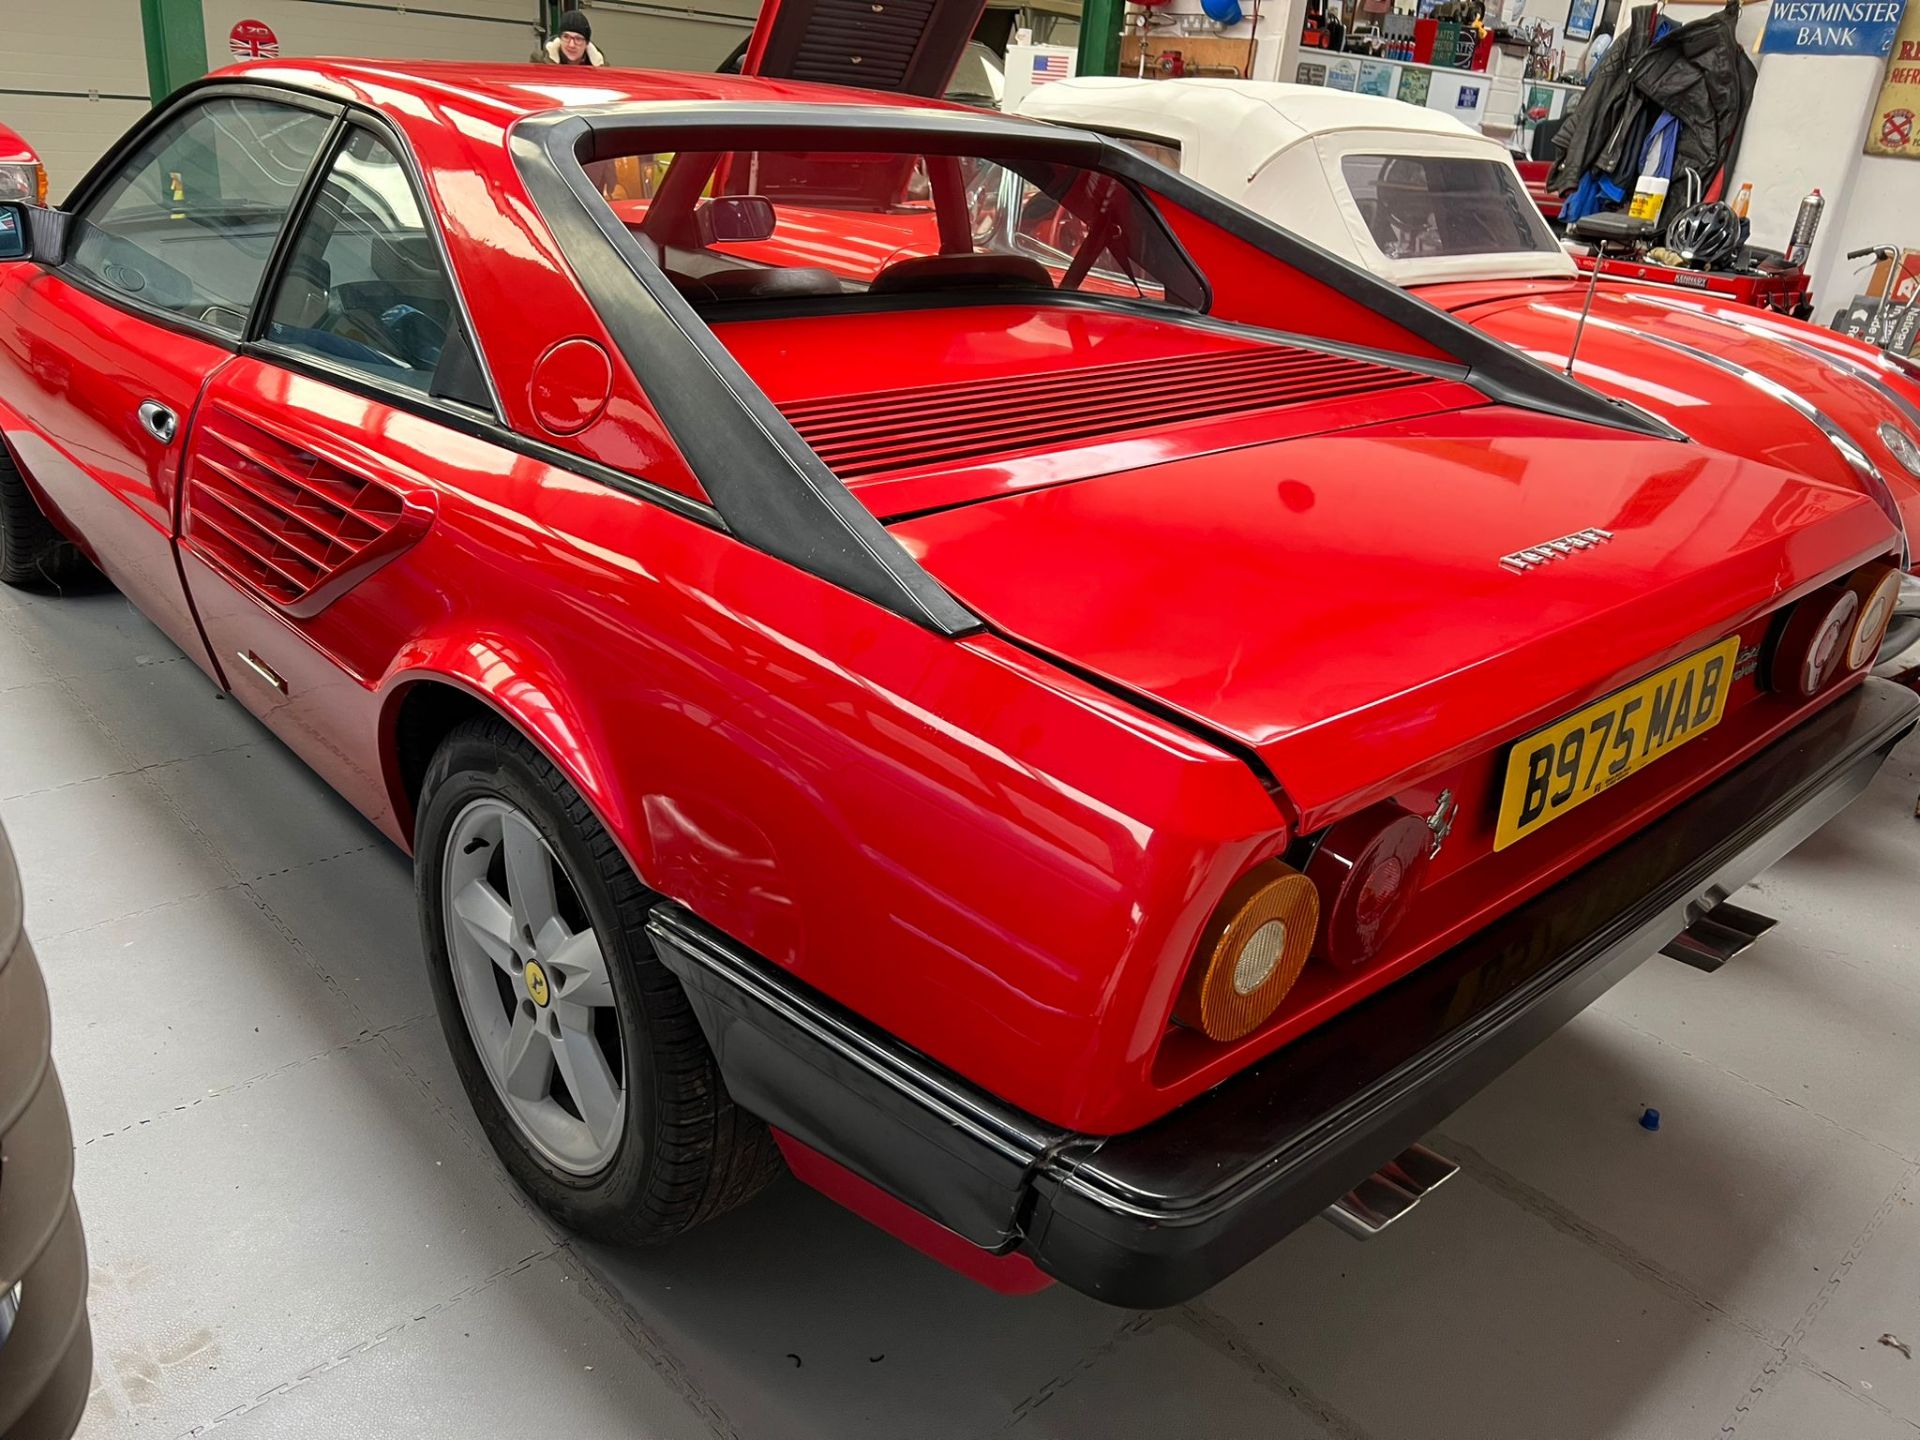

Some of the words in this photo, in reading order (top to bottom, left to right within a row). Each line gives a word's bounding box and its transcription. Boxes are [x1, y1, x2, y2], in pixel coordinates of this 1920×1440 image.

[1774, 3, 1900, 22] WESTMINSTER
[1796, 27, 1857, 46] BANK
[1500, 527, 1614, 570] Ferrari
[1517, 695, 1643, 830] B975
[1641, 655, 1725, 758] MAB
